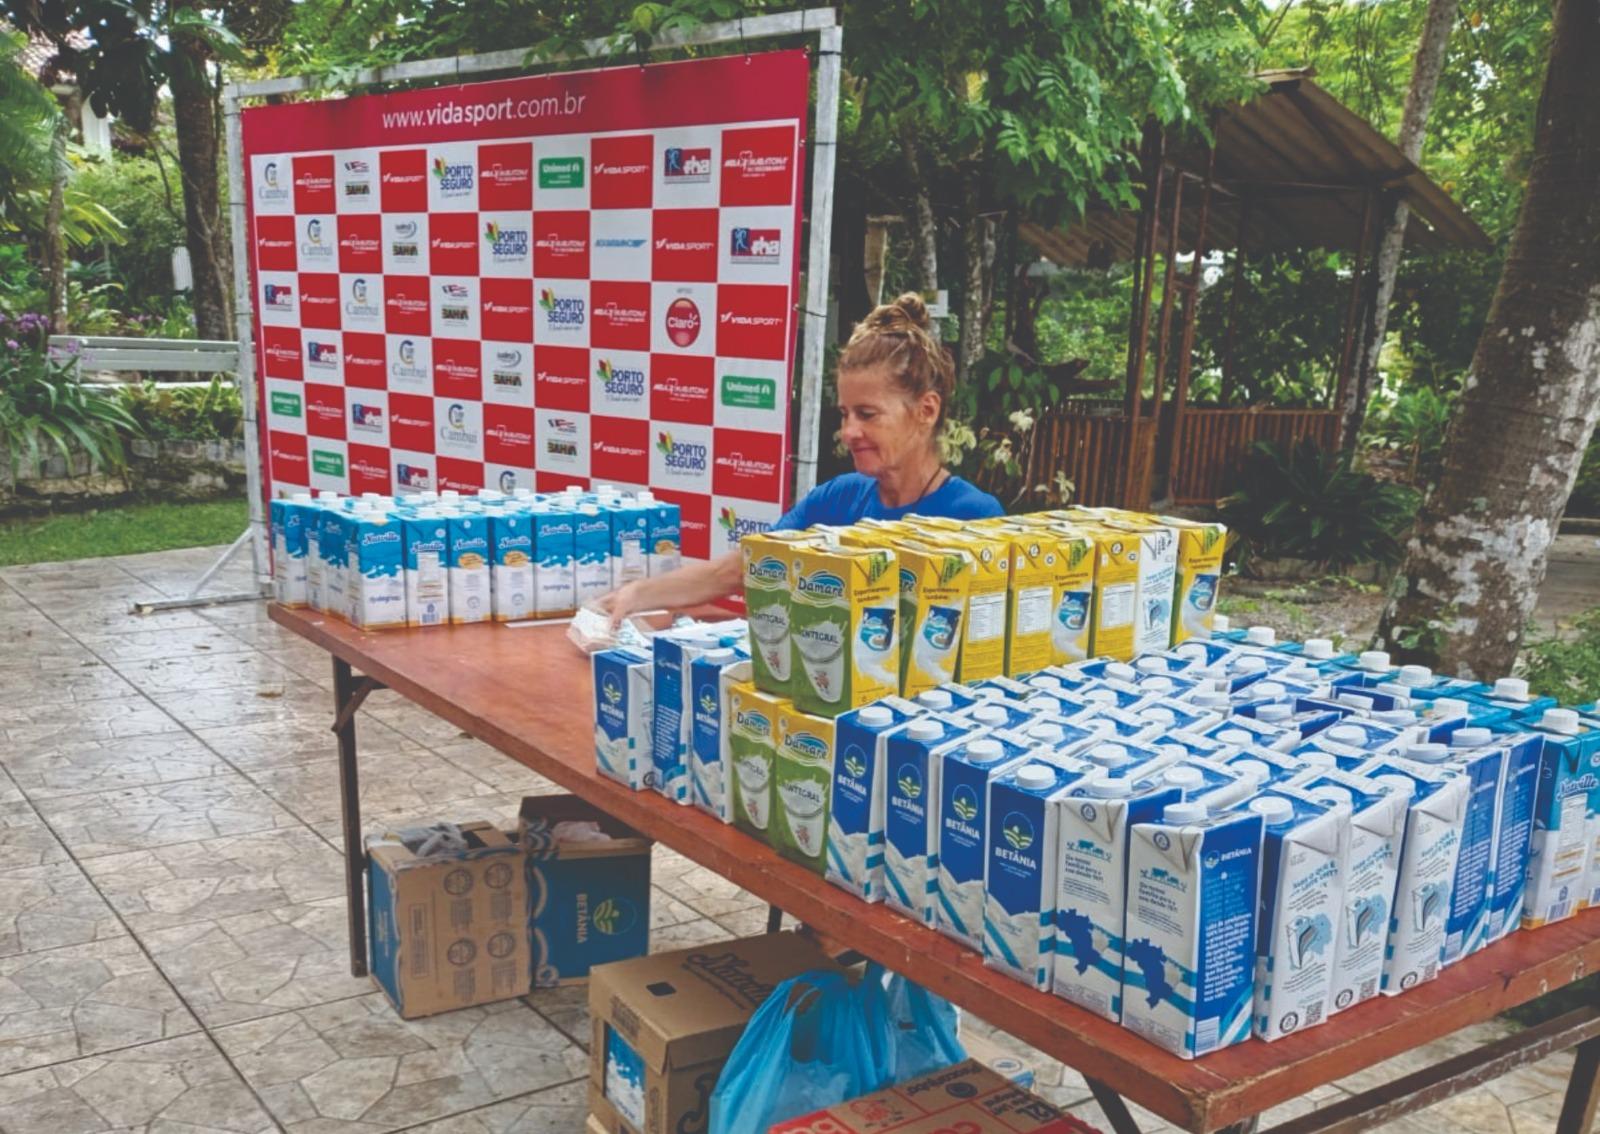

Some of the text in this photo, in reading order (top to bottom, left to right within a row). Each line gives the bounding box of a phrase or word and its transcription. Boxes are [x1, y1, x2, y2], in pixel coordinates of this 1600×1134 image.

[382, 91, 586, 128] www.vidasport.com.br
[444, 165, 473, 179] PORTO
[440, 178, 473, 191] SEGURO
[497, 230, 528, 243] PORTO
[492, 242, 528, 255] SEGURO
[554, 298, 584, 312] PORTO
[548, 311, 584, 325] SEGURO
[668, 315, 695, 330] Claro
[611, 370, 645, 384] PORTO
[605, 381, 644, 396] SEGURO
[726, 380, 760, 395] Unimed
[672, 443, 707, 458] PORTO
[665, 454, 706, 470] SEGURO
[797, 577, 844, 597] Damare
[837, 774, 867, 796] BETÂNIA
[891, 795, 924, 817] BETÂNIA
[945, 817, 980, 841] BETÂNIA
[995, 846, 1037, 871] BETÂNIA
[576, 893, 590, 944] BETÂNIA
